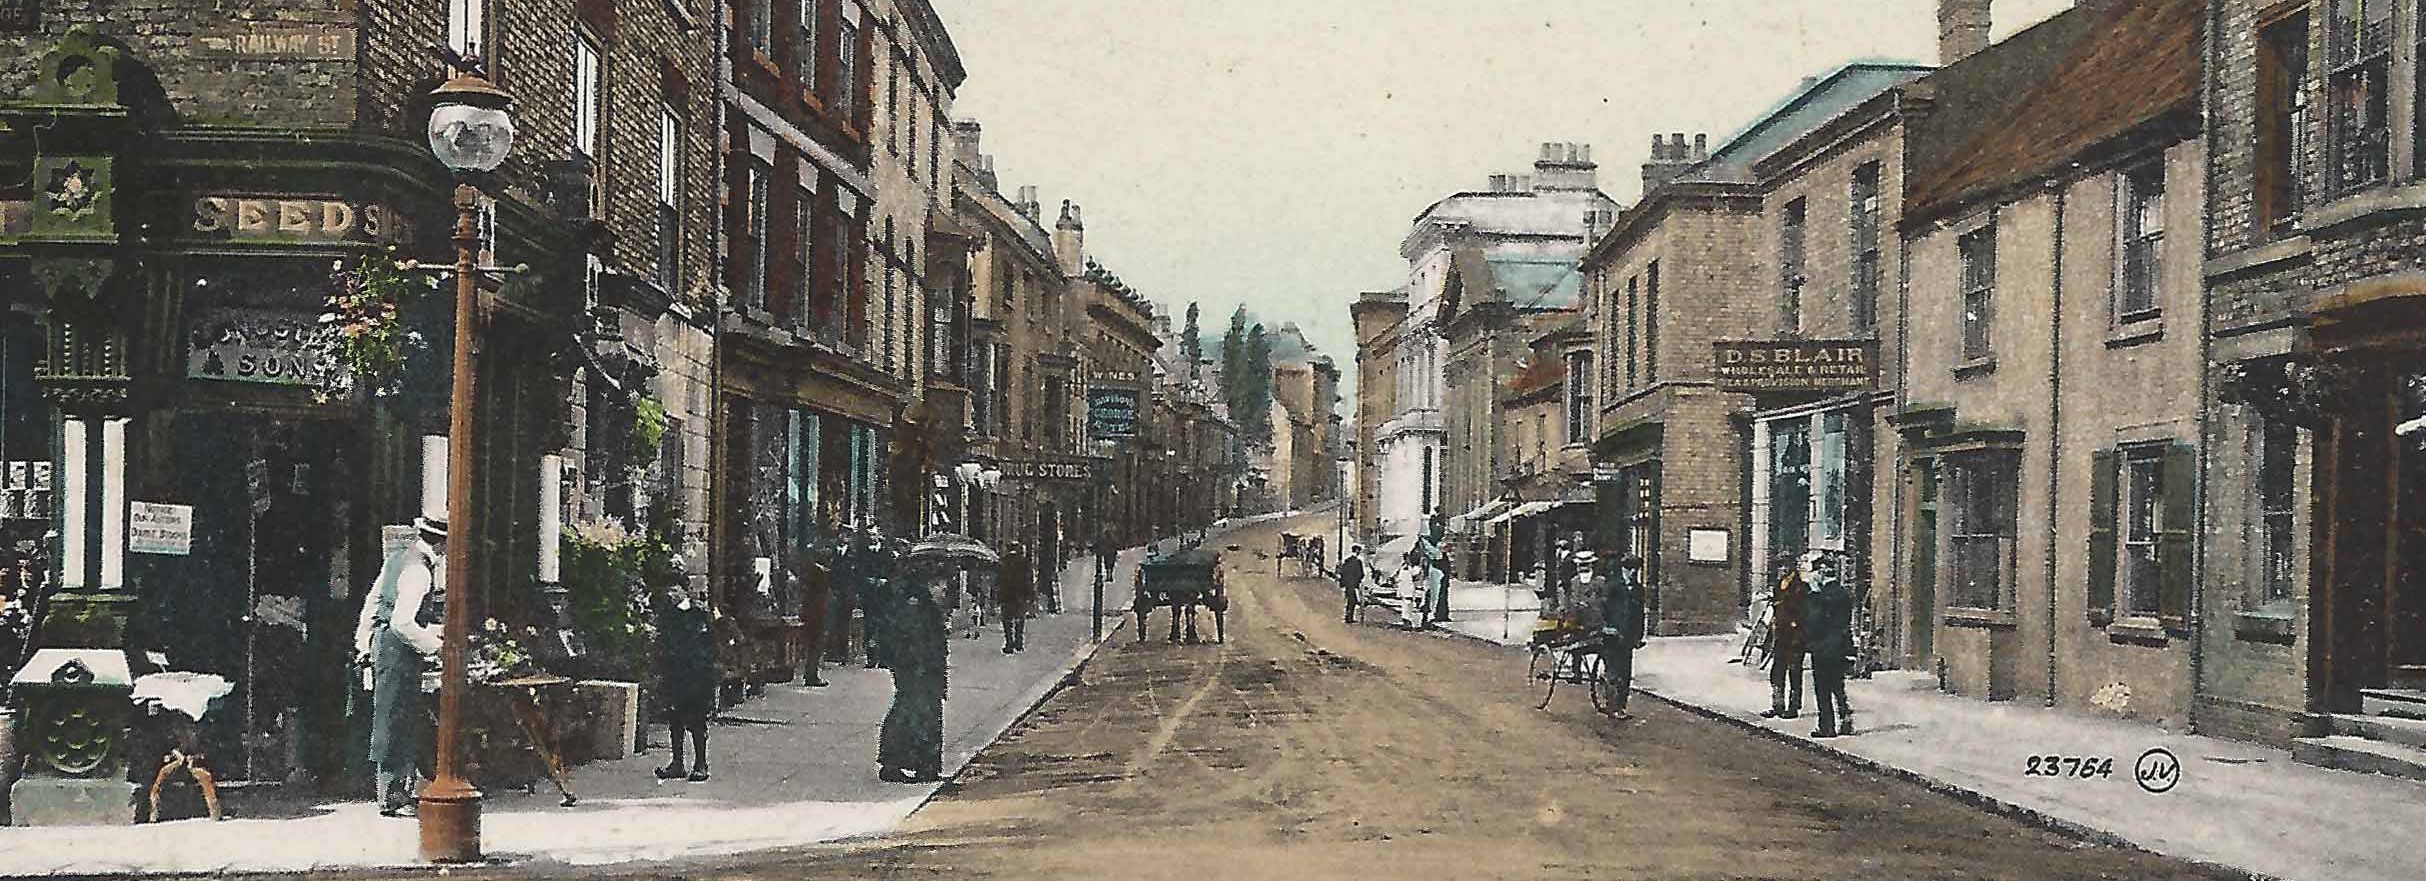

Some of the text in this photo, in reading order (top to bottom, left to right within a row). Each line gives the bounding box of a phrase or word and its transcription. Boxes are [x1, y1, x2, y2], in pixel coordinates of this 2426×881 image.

[235, 34, 308, 54] RAILWAY
[193, 197, 379, 236] SEEDS
[1774, 347, 1864, 363] BLAIR
[1093, 371, 1136, 381] WNES
[1038, 463, 1092, 479] STORES
